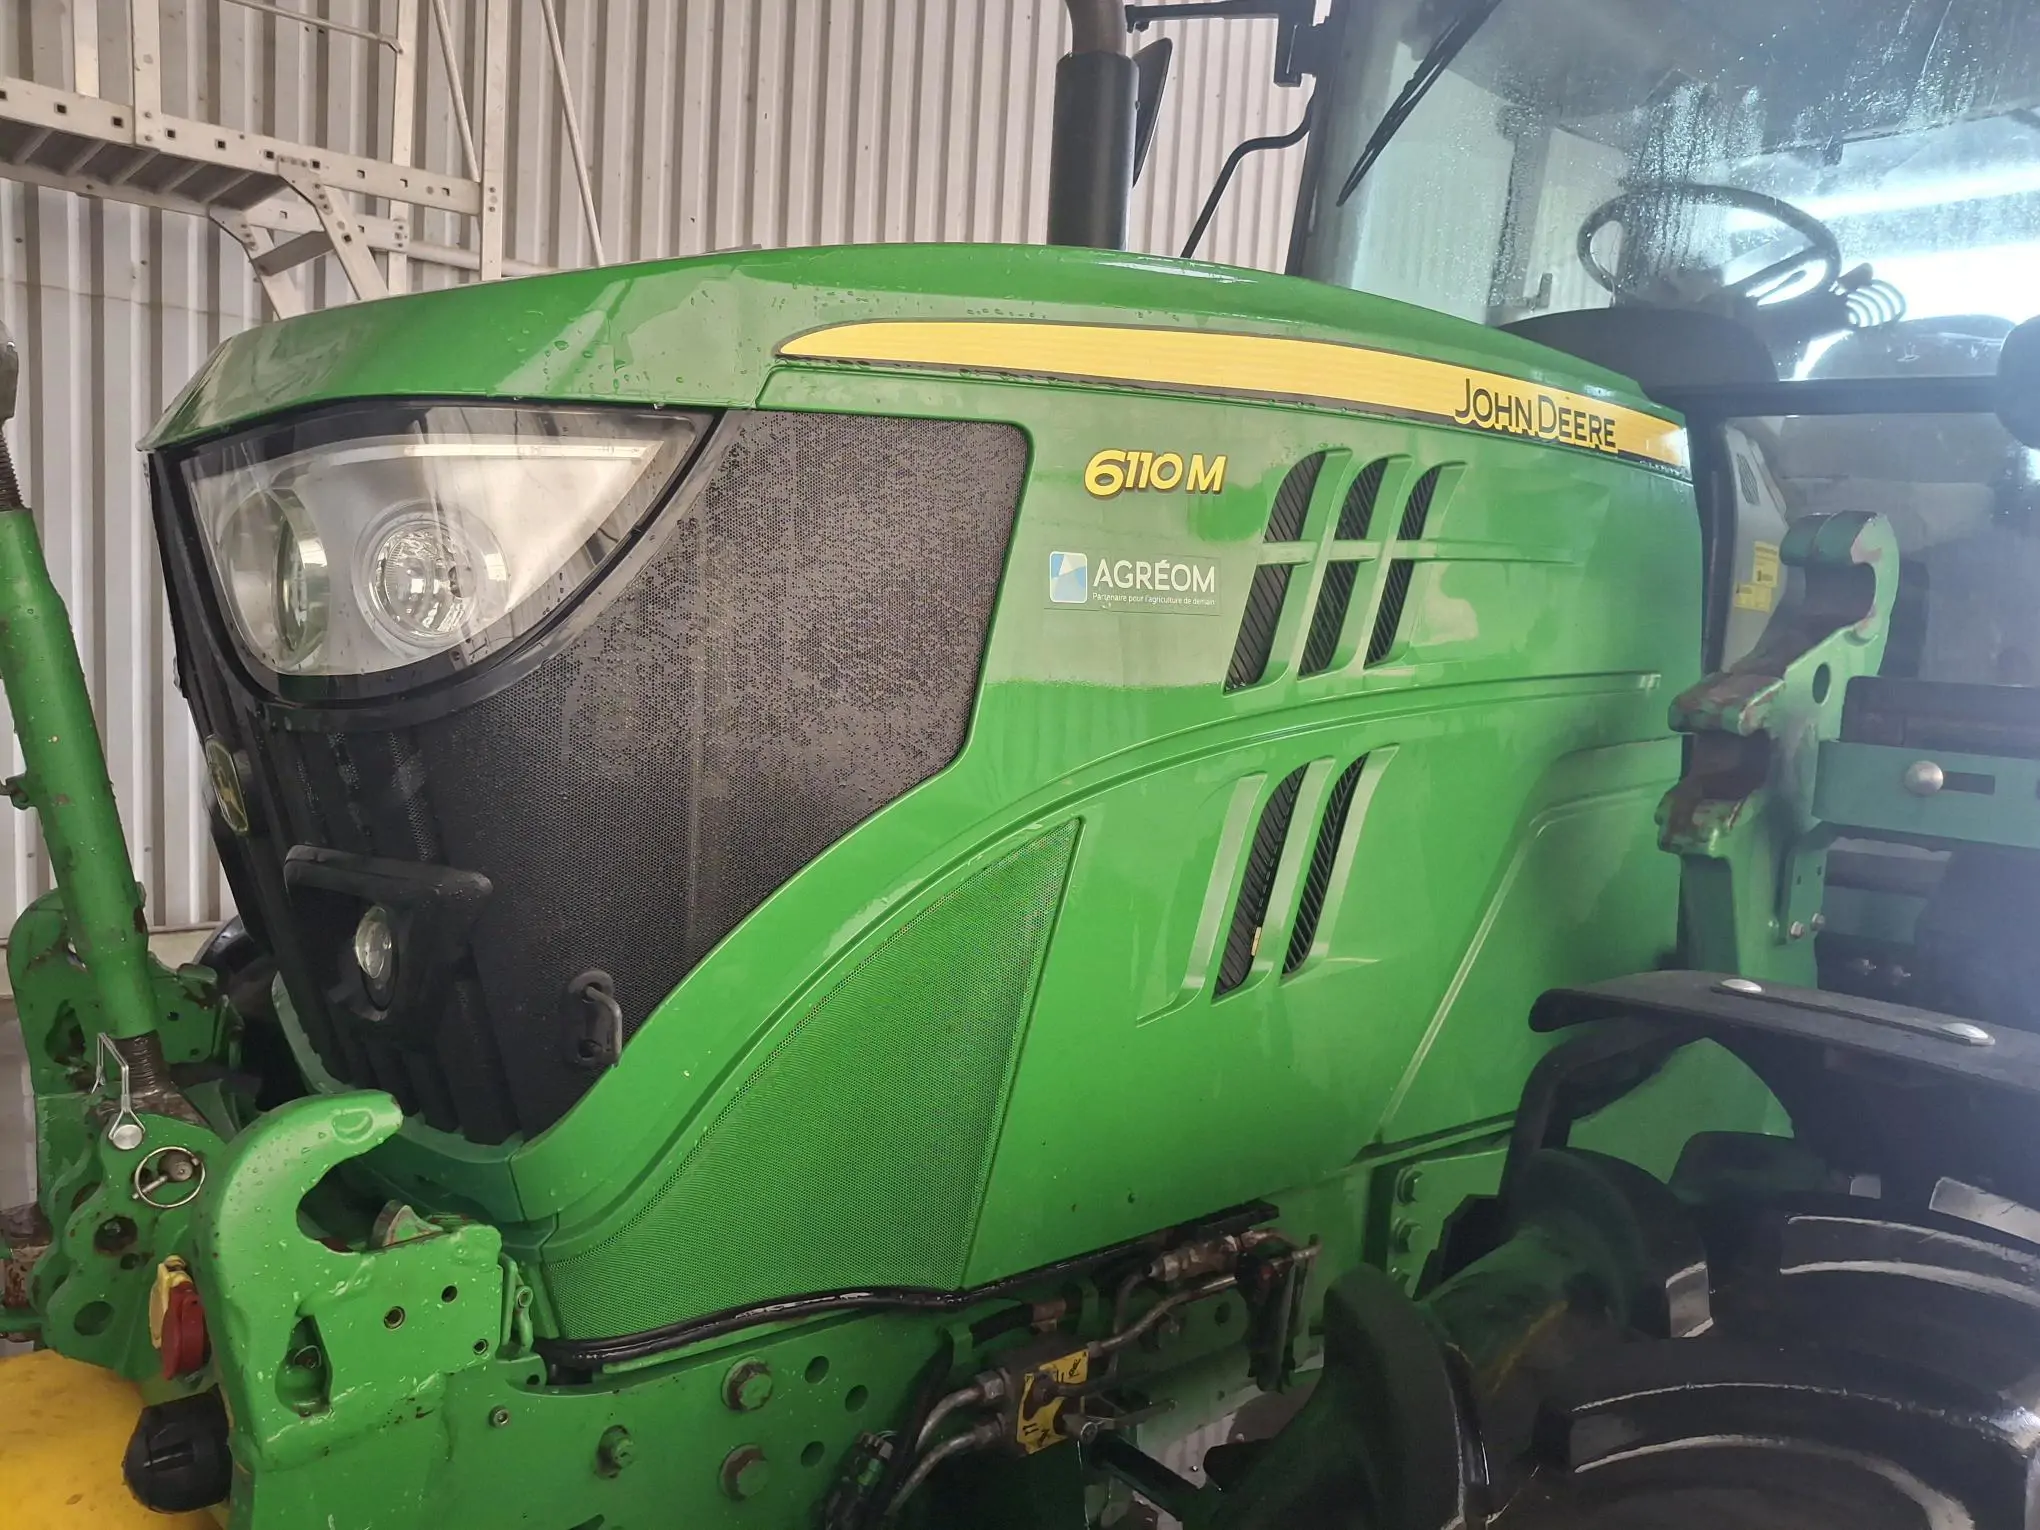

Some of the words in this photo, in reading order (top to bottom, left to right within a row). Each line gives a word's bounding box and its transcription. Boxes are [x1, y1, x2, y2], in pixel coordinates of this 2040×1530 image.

[1454, 378, 1532, 431] JOHN
[1537, 394, 1617, 449] DEERE
[1092, 558, 1216, 593] AGRÉOM
[1092, 592, 1127, 602] Partenaire
[1128, 595, 1144, 604] pour
